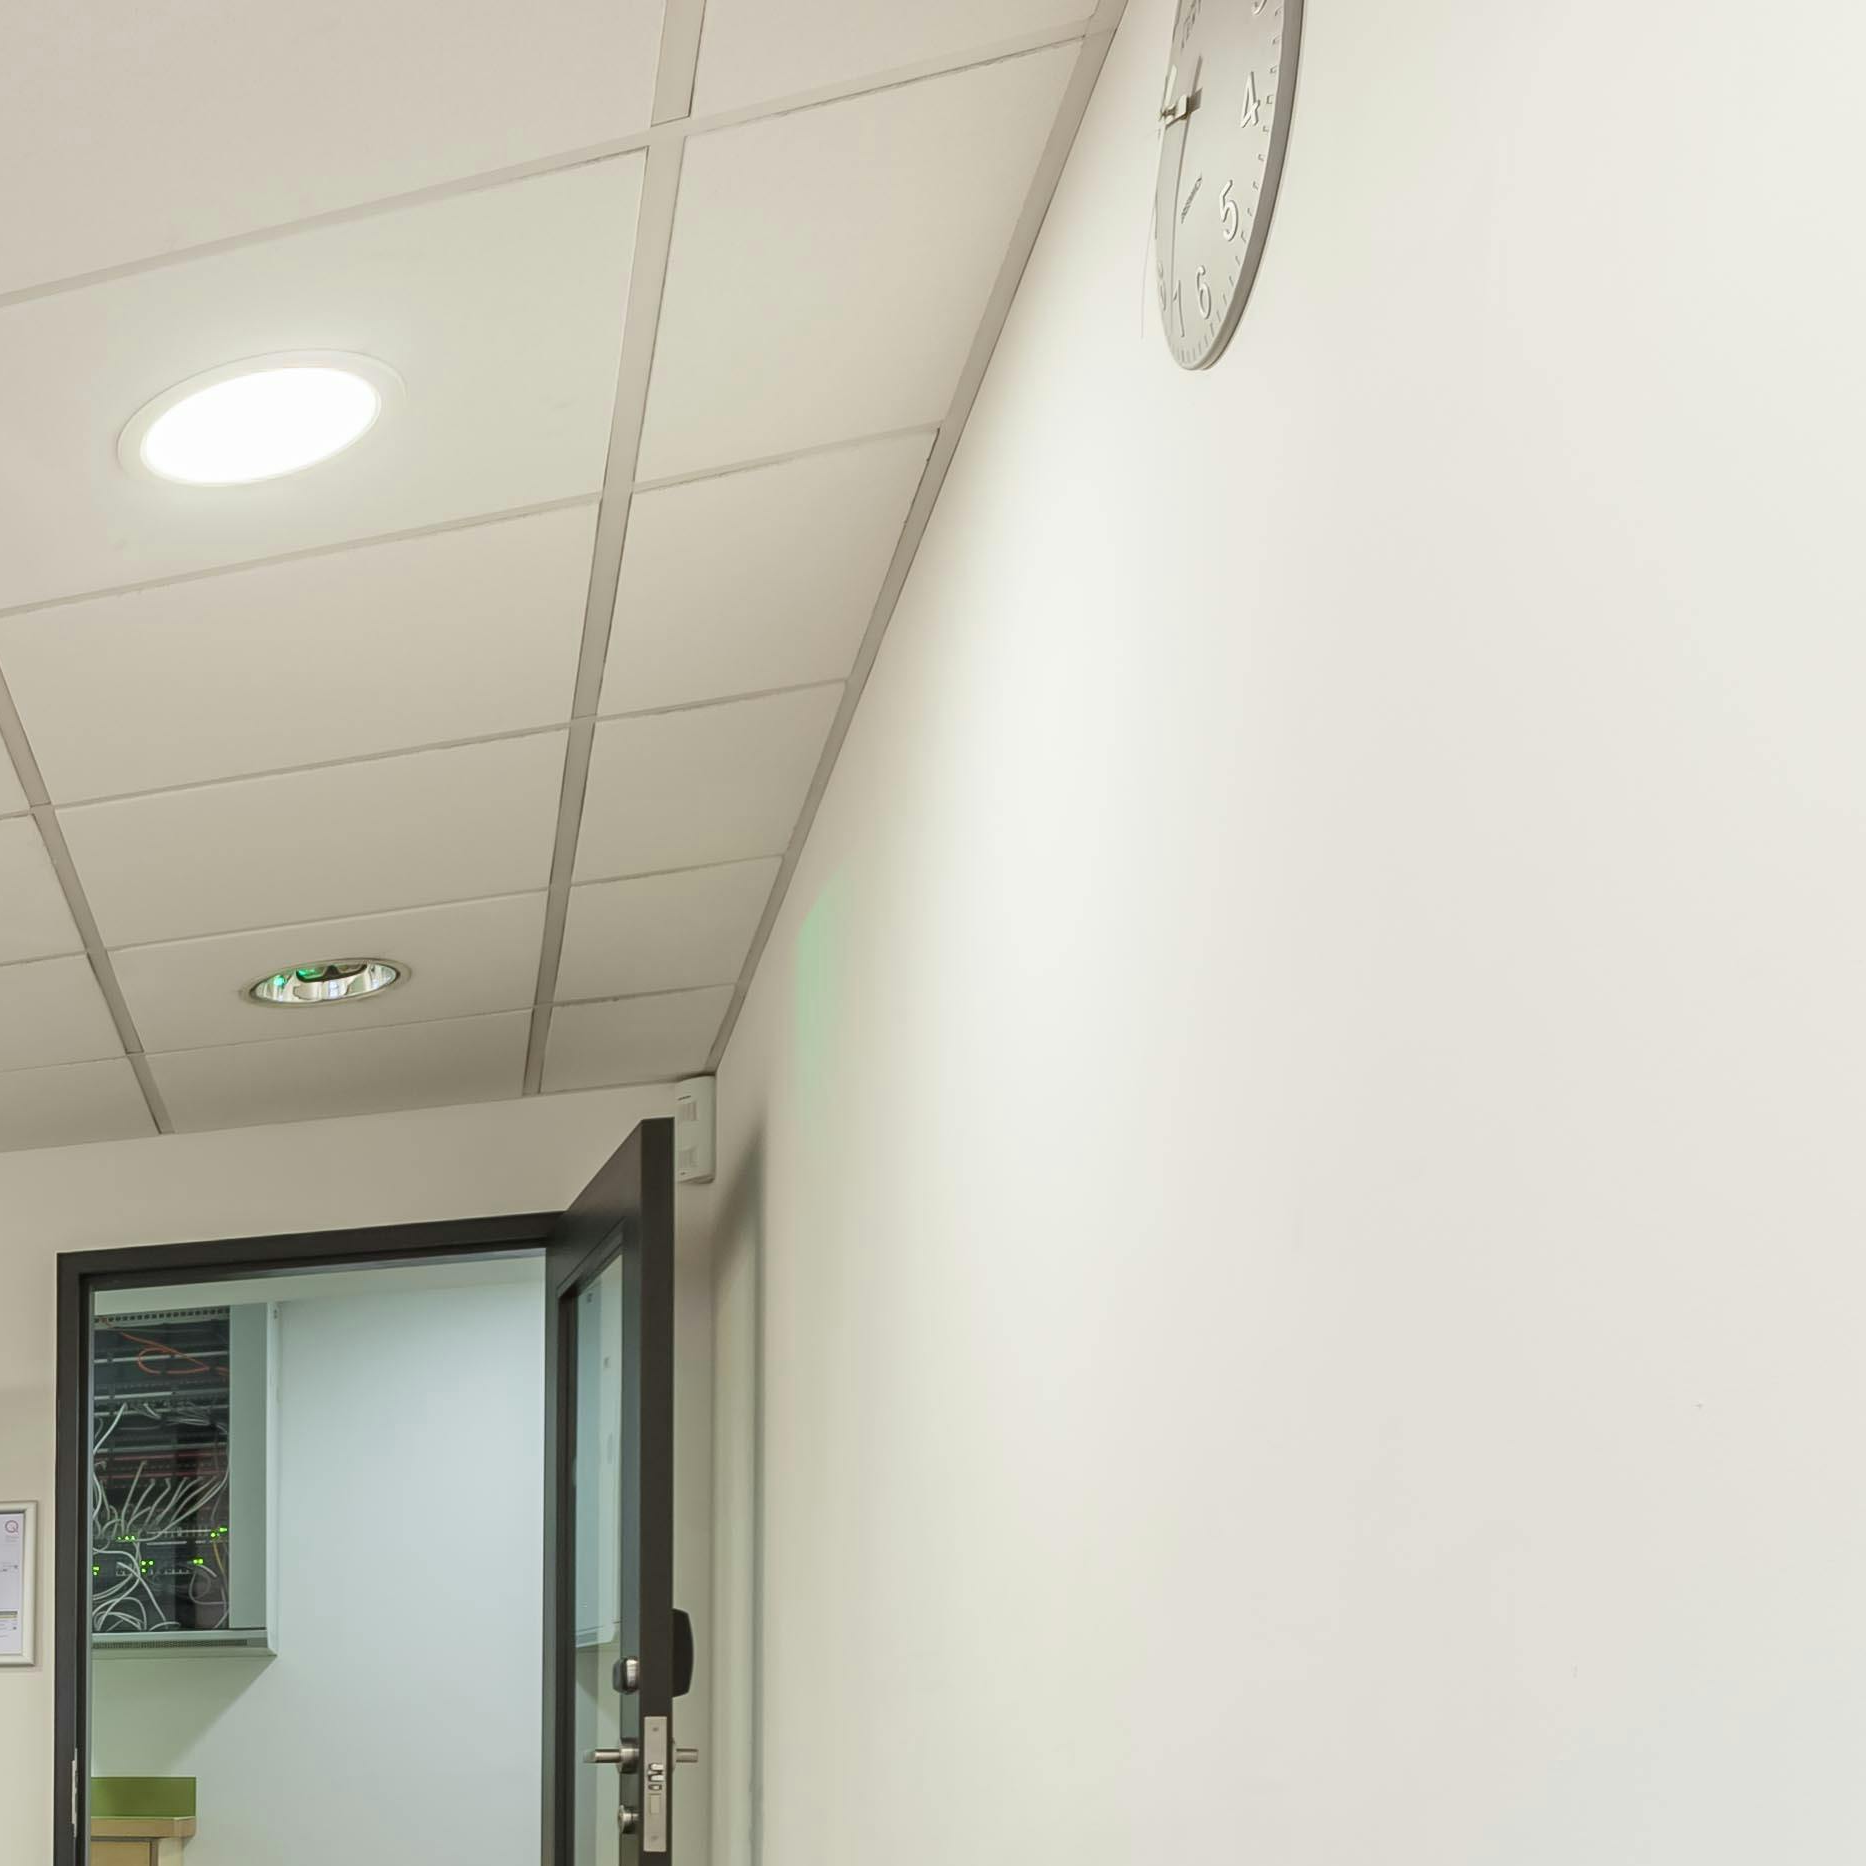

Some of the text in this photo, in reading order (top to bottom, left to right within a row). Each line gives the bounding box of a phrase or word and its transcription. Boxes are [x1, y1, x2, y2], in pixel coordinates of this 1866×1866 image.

[1240, 71, 1261, 129] 4
[1218, 179, 1239, 243] 5
[1196, 264, 1212, 321] 6
